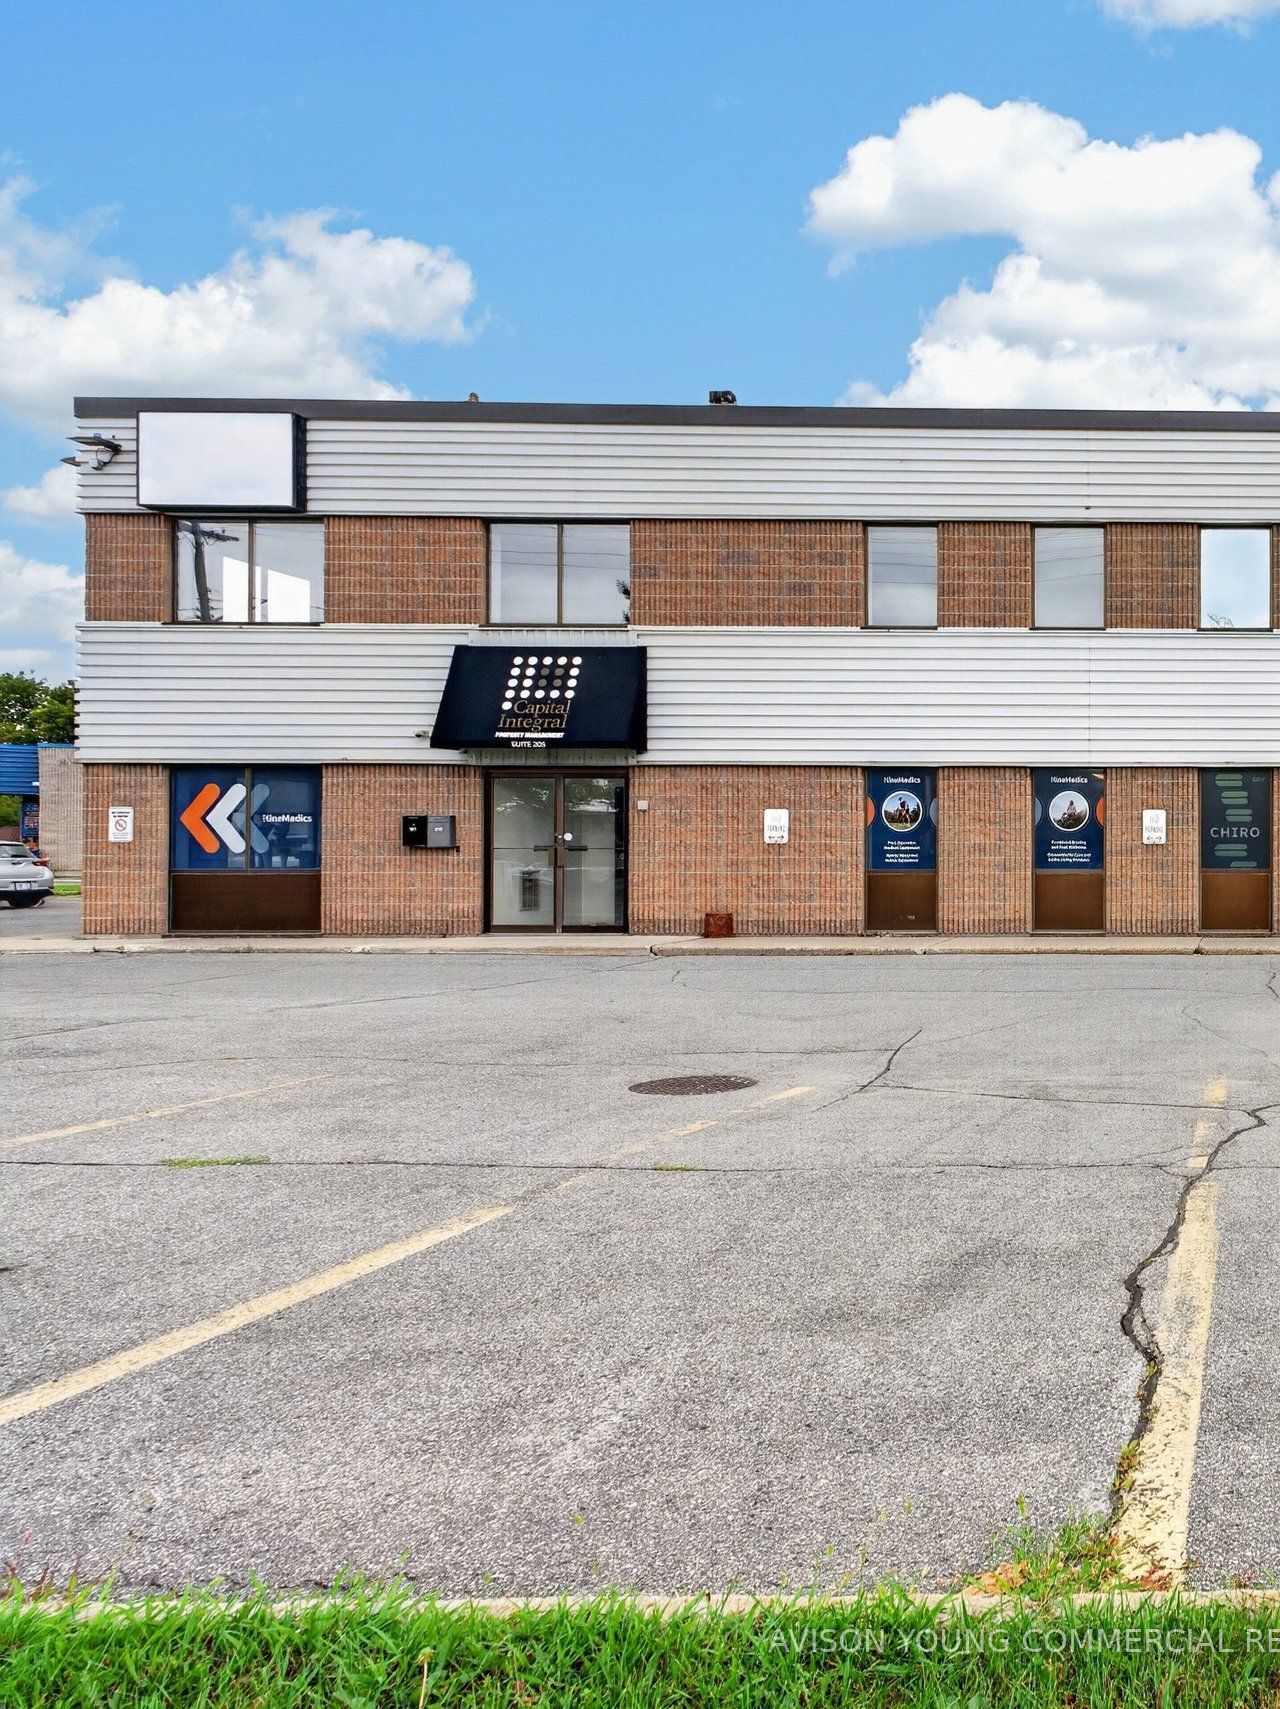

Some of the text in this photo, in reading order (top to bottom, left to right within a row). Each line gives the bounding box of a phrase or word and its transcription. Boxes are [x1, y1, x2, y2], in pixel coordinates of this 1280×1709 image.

[513, 699, 571, 718] Capital
[498, 713, 568, 732] Integral
[1210, 827, 1260, 838] CHIRO
